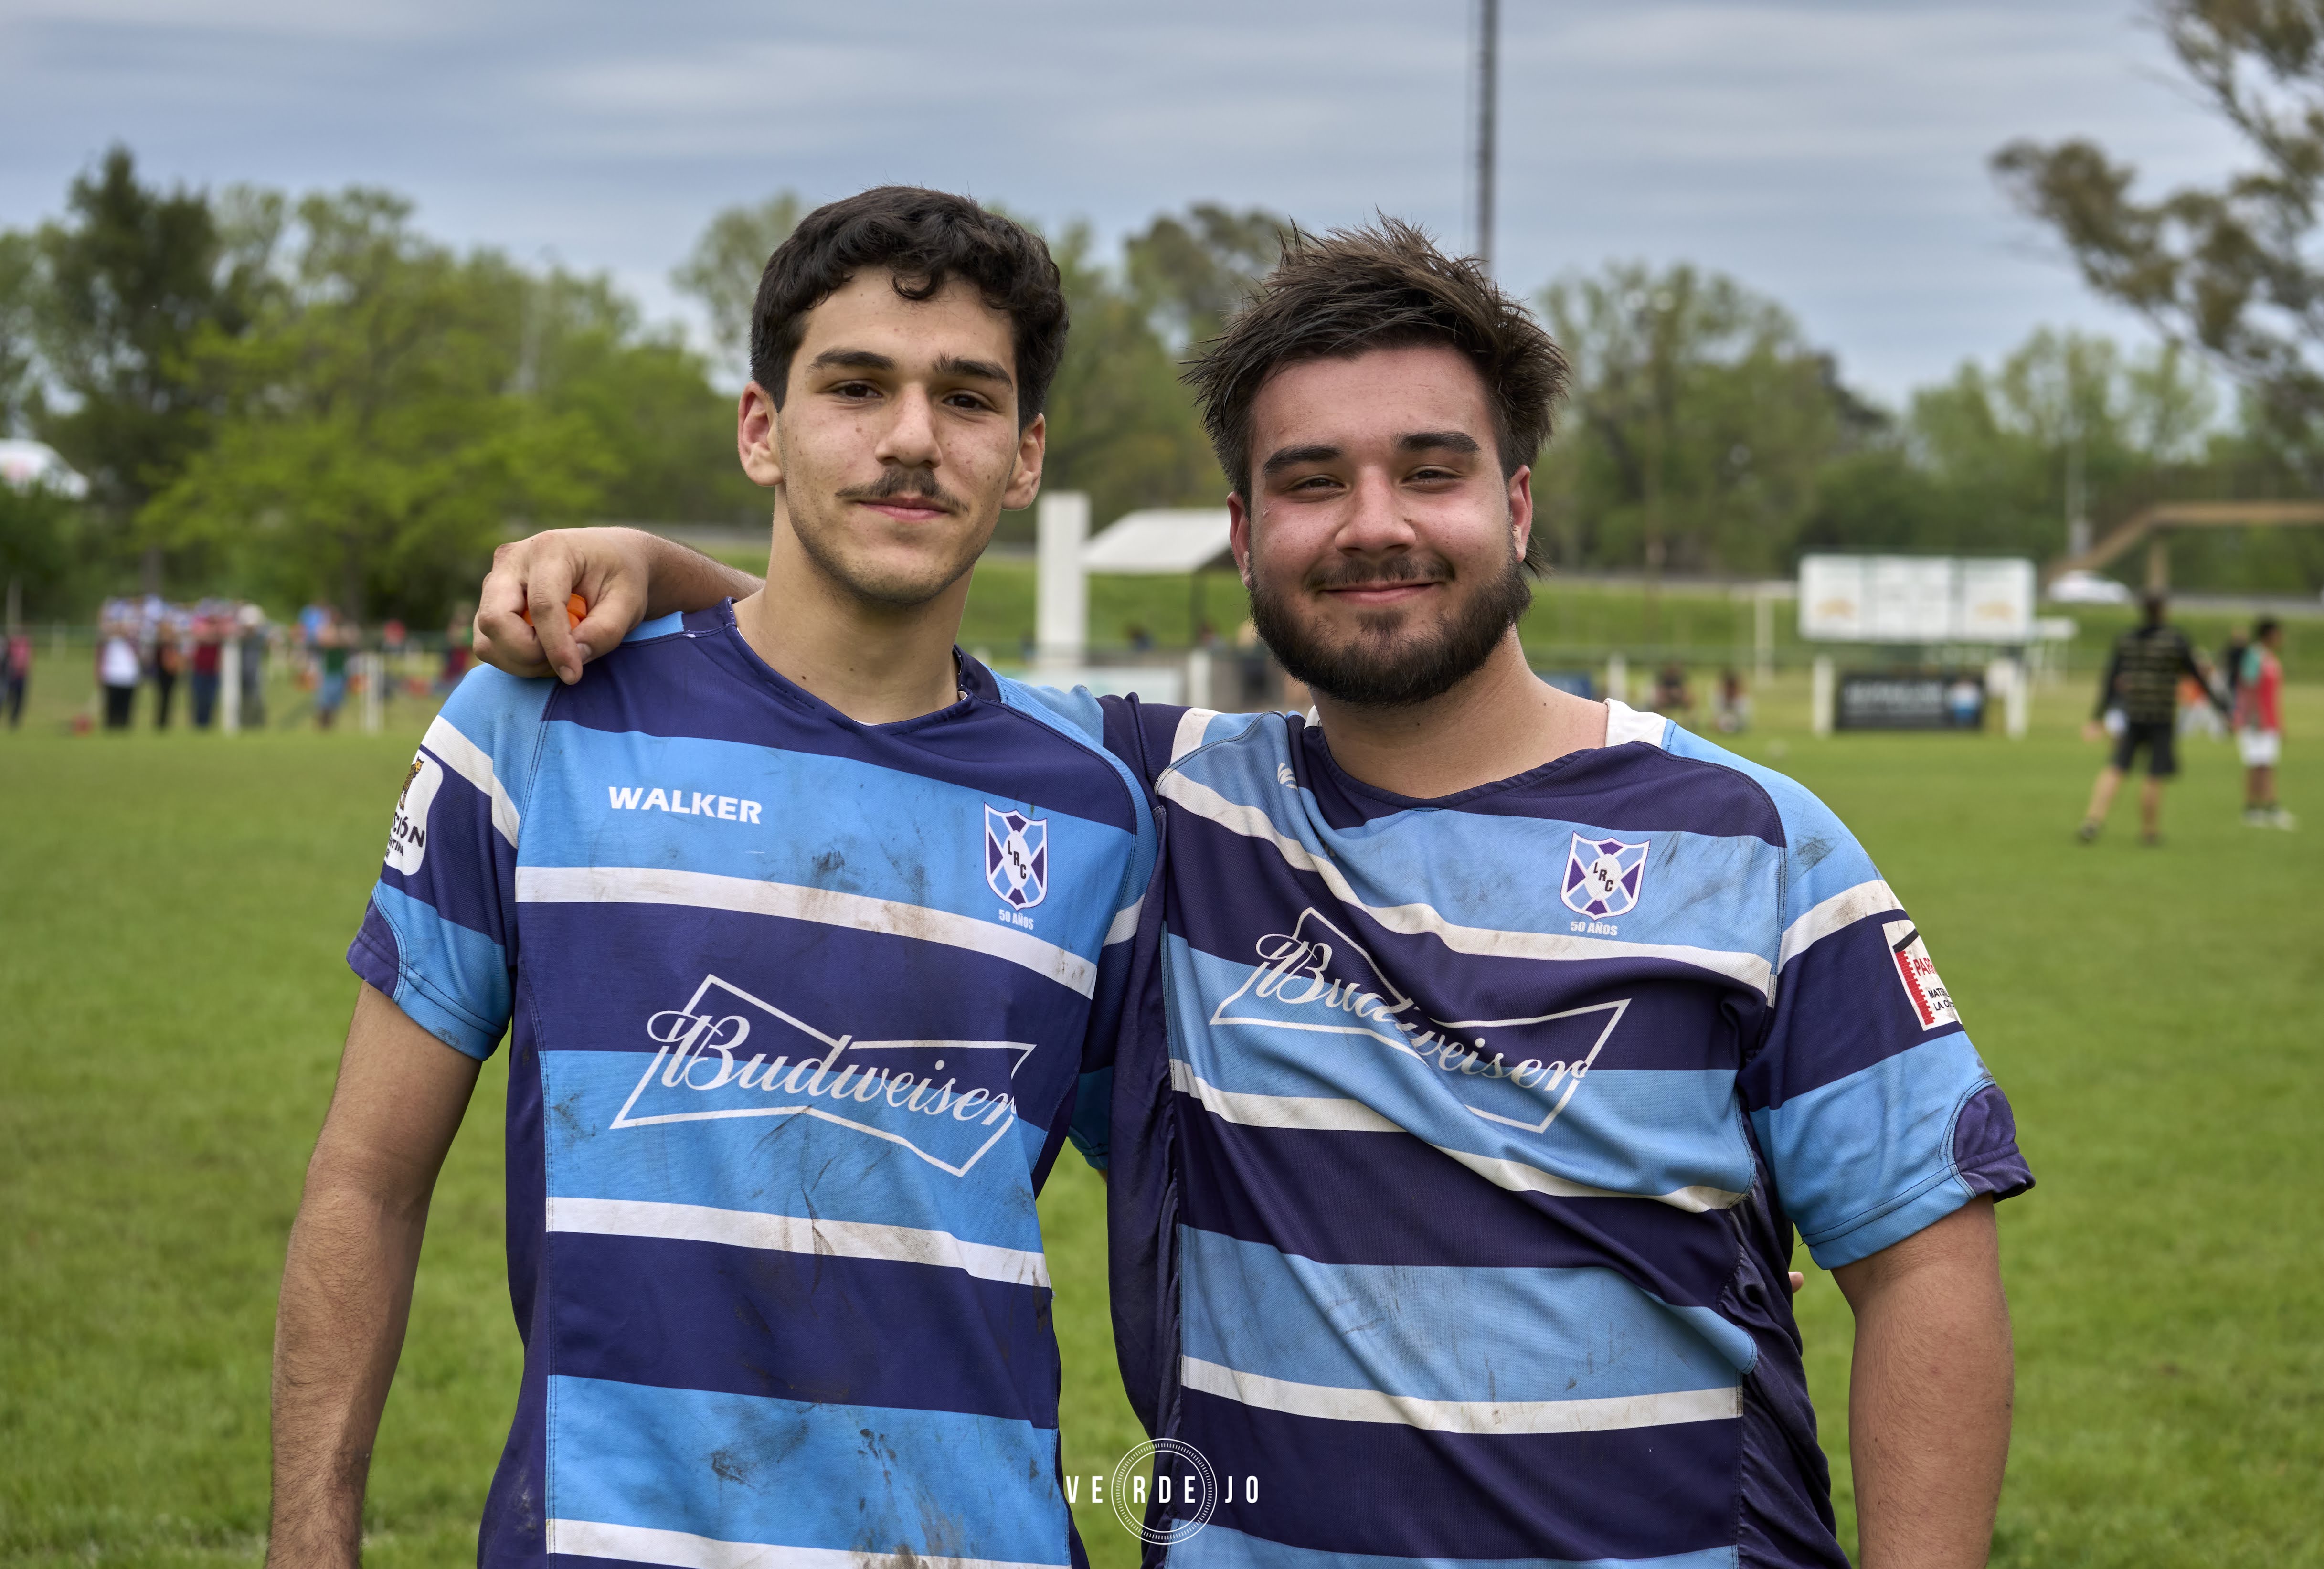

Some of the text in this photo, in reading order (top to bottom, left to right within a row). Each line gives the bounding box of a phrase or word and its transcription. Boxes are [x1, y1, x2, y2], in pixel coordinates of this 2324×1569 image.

[608, 786, 762, 824] WALKER
[392, 812, 425, 848] CIÓN
[1008, 840, 1027, 879] LRC
[1593, 862, 1613, 892] LRC
[998, 909, 1034, 930] 50 AÑOS
[1570, 921, 1618, 936] 50 AÑOS
[1255, 933, 1588, 1092] Budweiser
[1933, 1001, 1944, 1011] LA
[647, 1009, 1017, 1126] Budweiser
